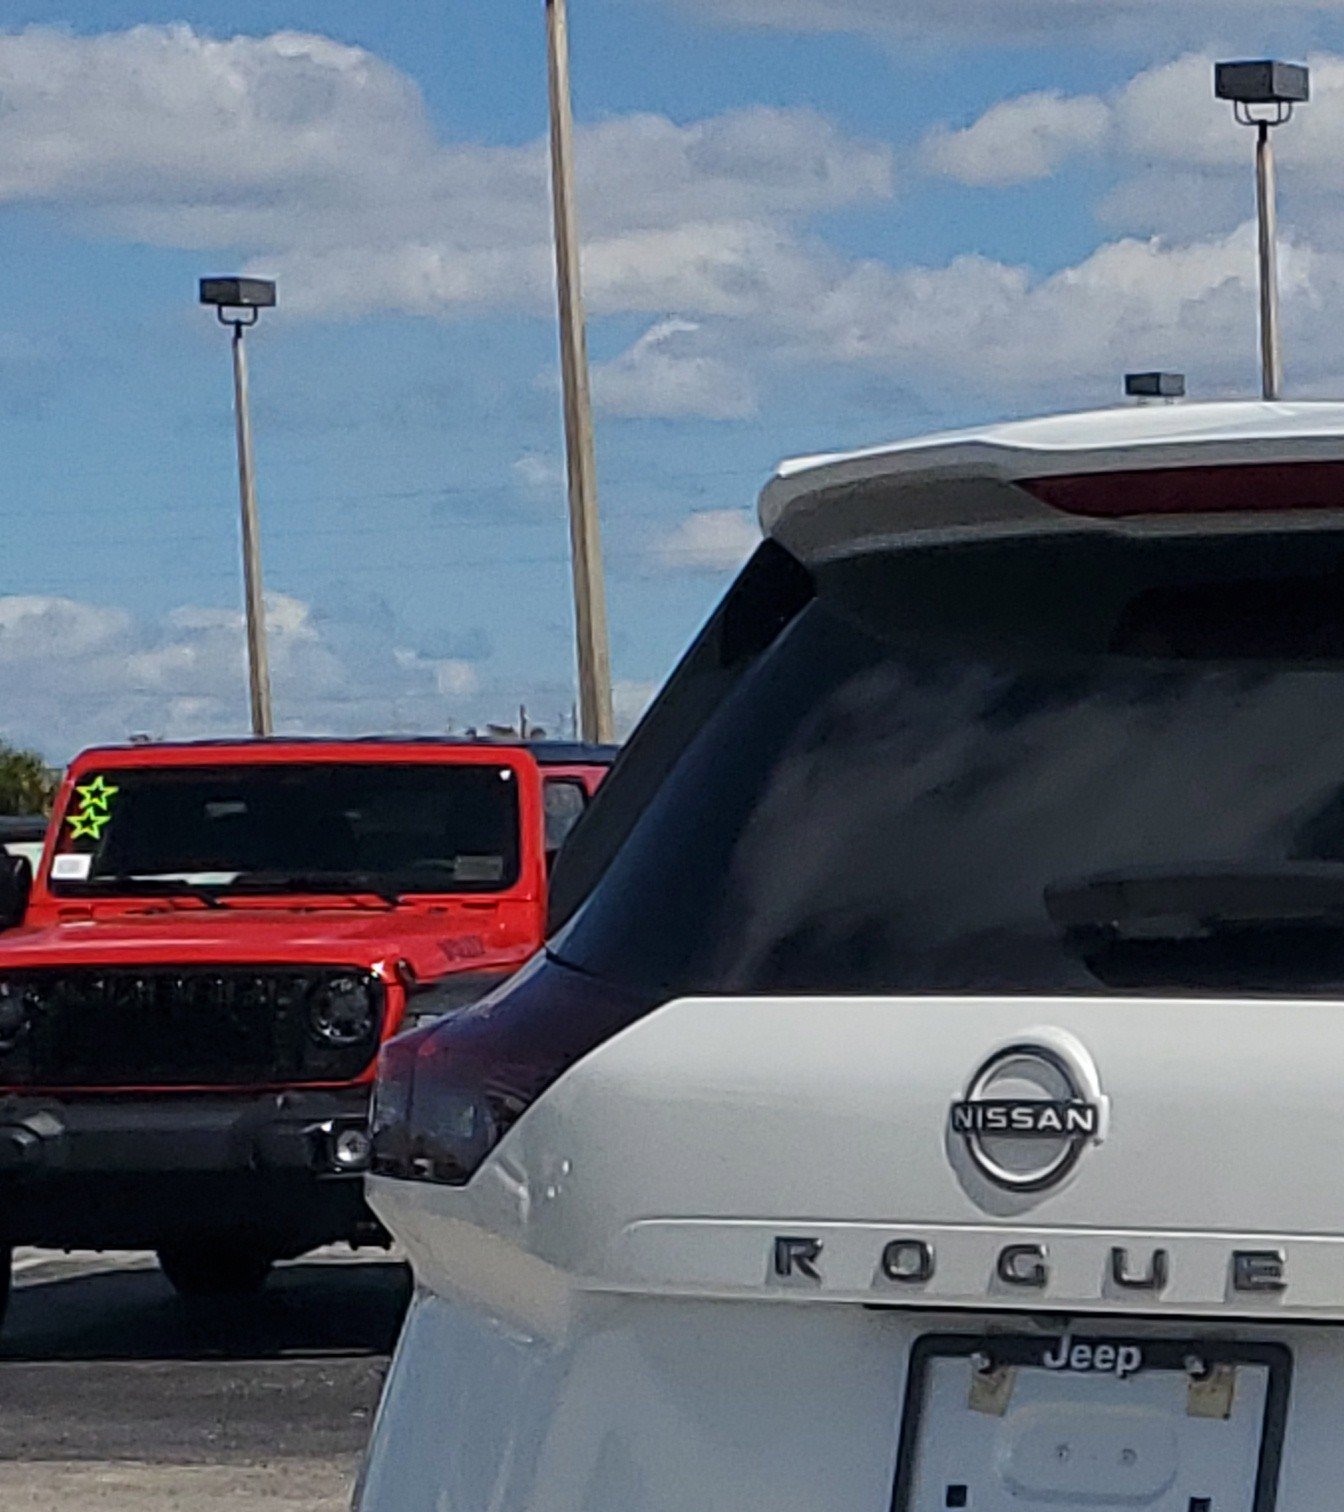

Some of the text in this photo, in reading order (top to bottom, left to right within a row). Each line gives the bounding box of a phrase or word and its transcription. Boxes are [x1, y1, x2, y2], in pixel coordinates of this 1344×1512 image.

[953, 1106, 1094, 1132] NISSAN
[774, 1236, 1289, 1291] ROGUE
[1043, 1333, 1143, 1377] Jeep
